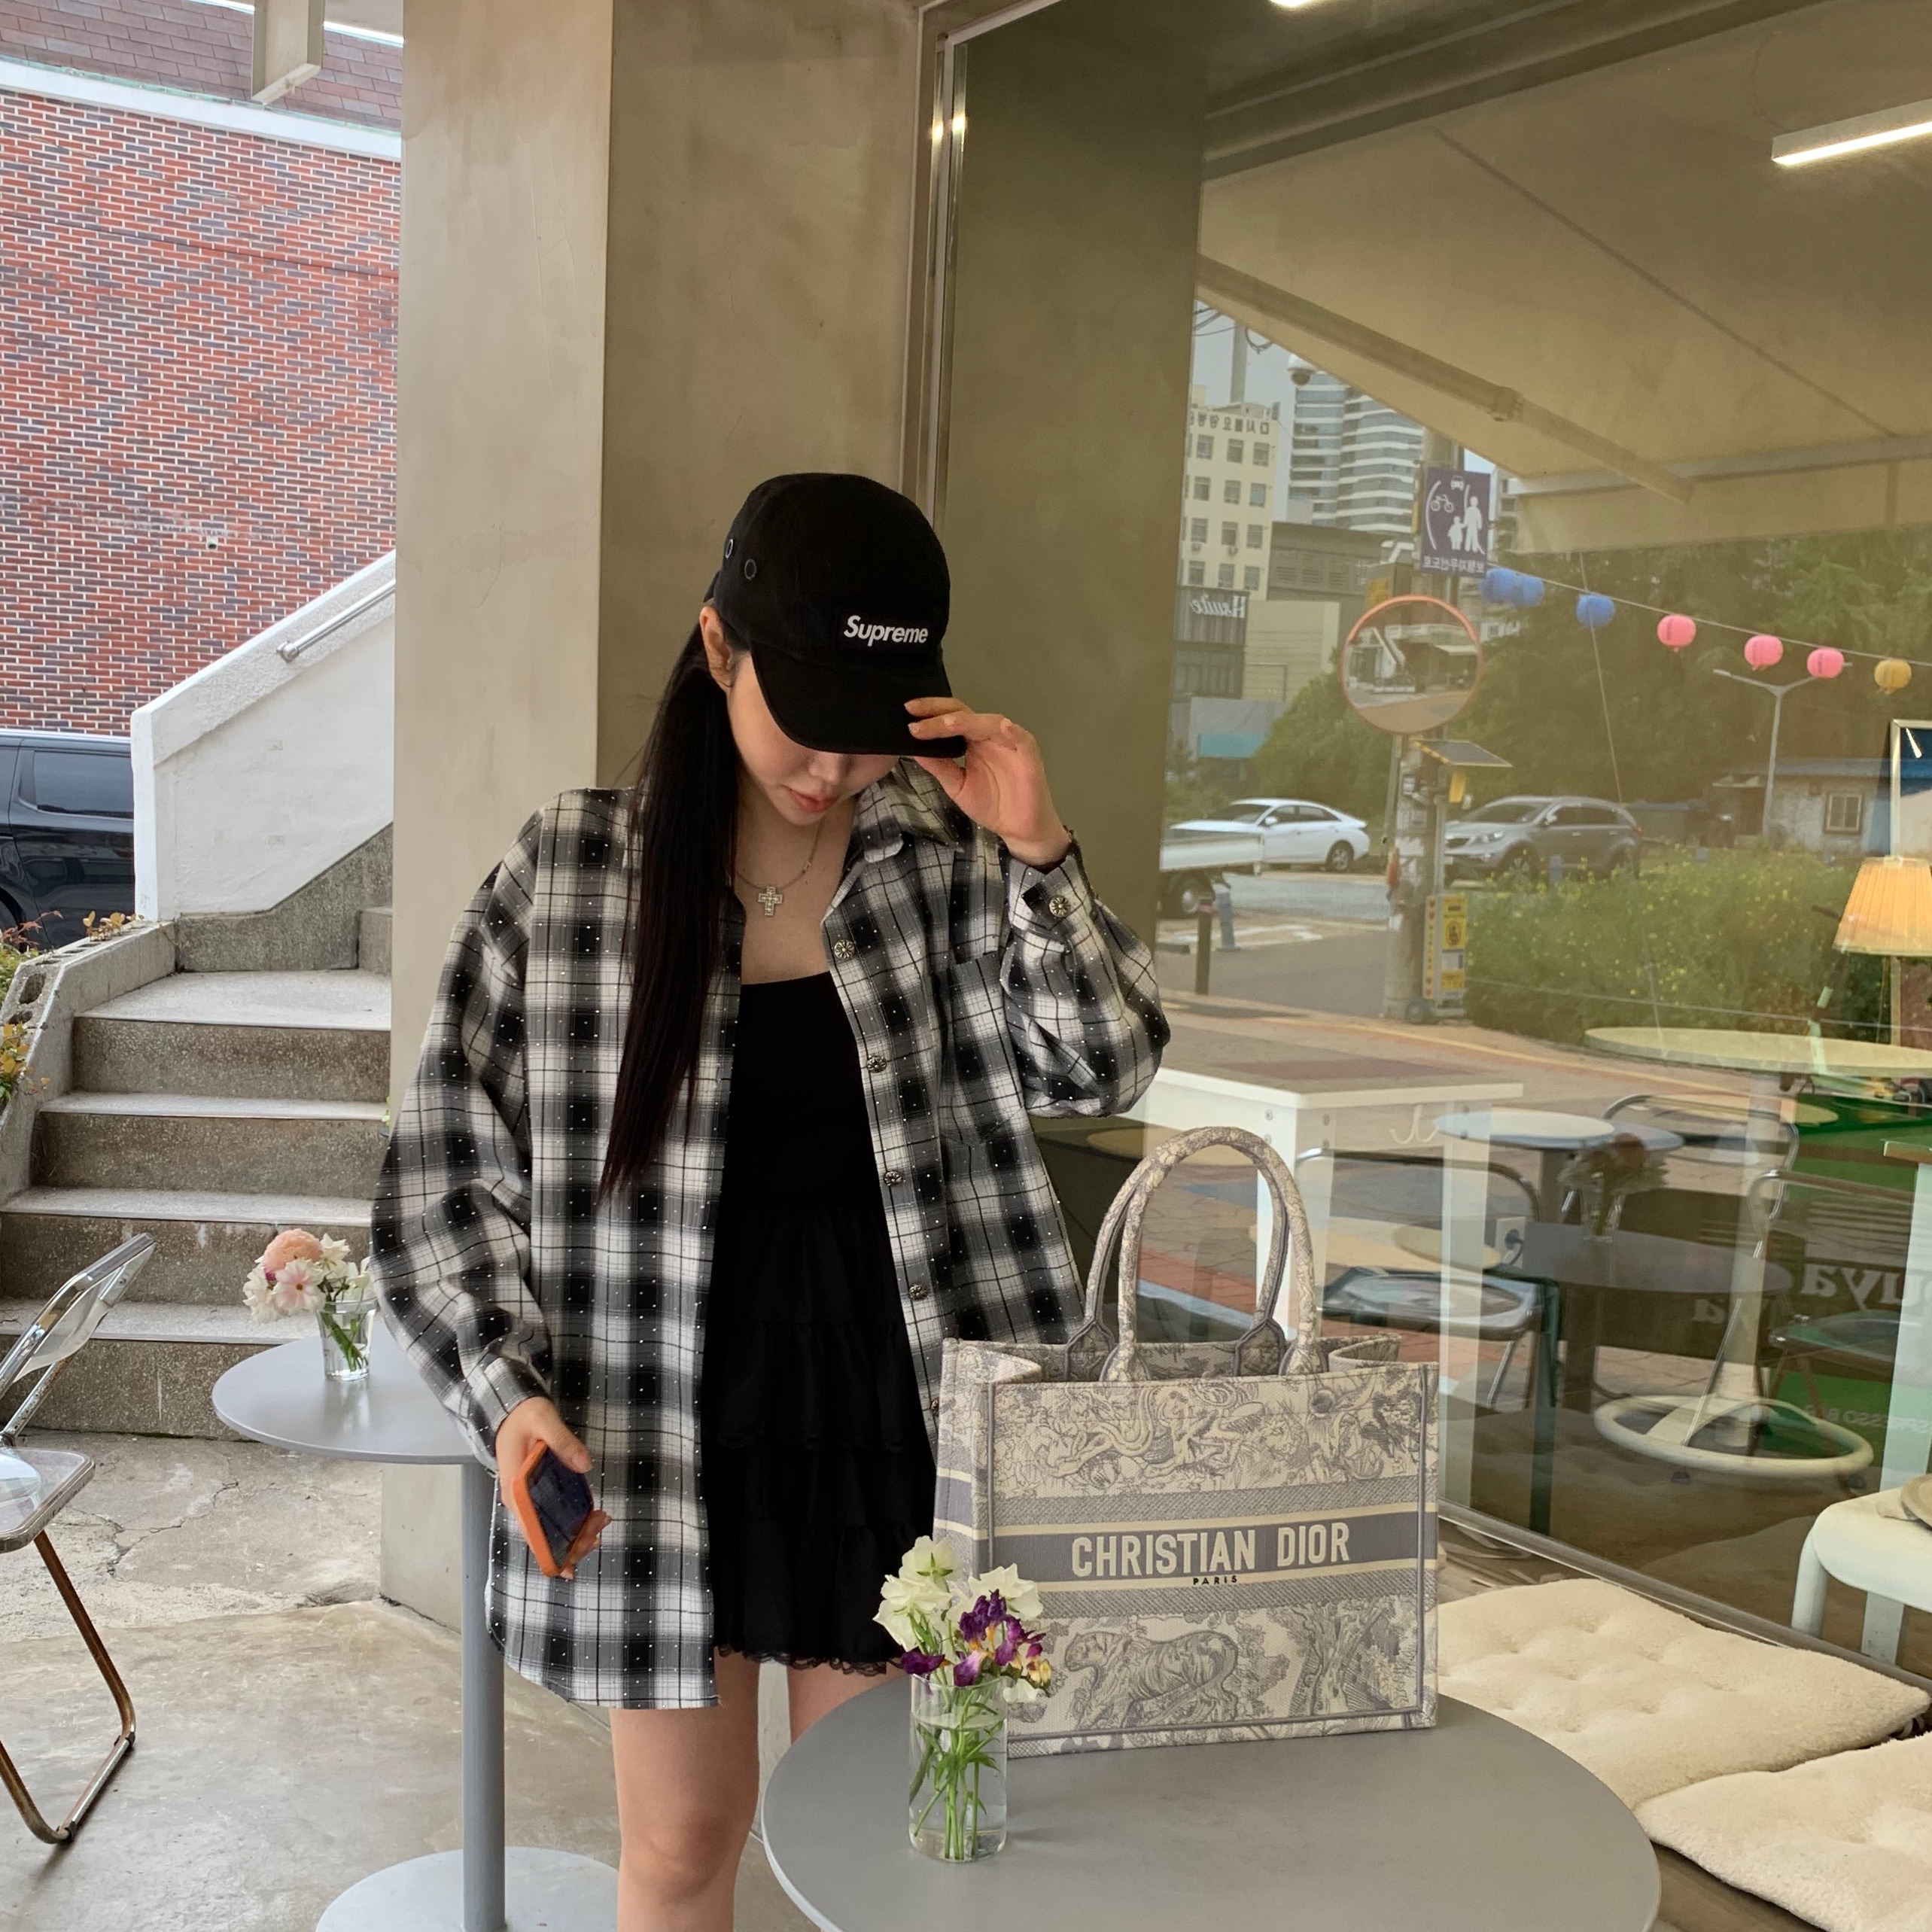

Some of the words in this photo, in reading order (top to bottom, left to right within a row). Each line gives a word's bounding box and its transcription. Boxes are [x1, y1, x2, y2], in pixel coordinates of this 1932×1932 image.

[843, 615, 929, 647] Supreme
[1072, 1529, 1255, 1578] CHRISTIAN
[1277, 1523, 1349, 1568] DIOR
[1193, 1575, 1237, 1586] PARIS
